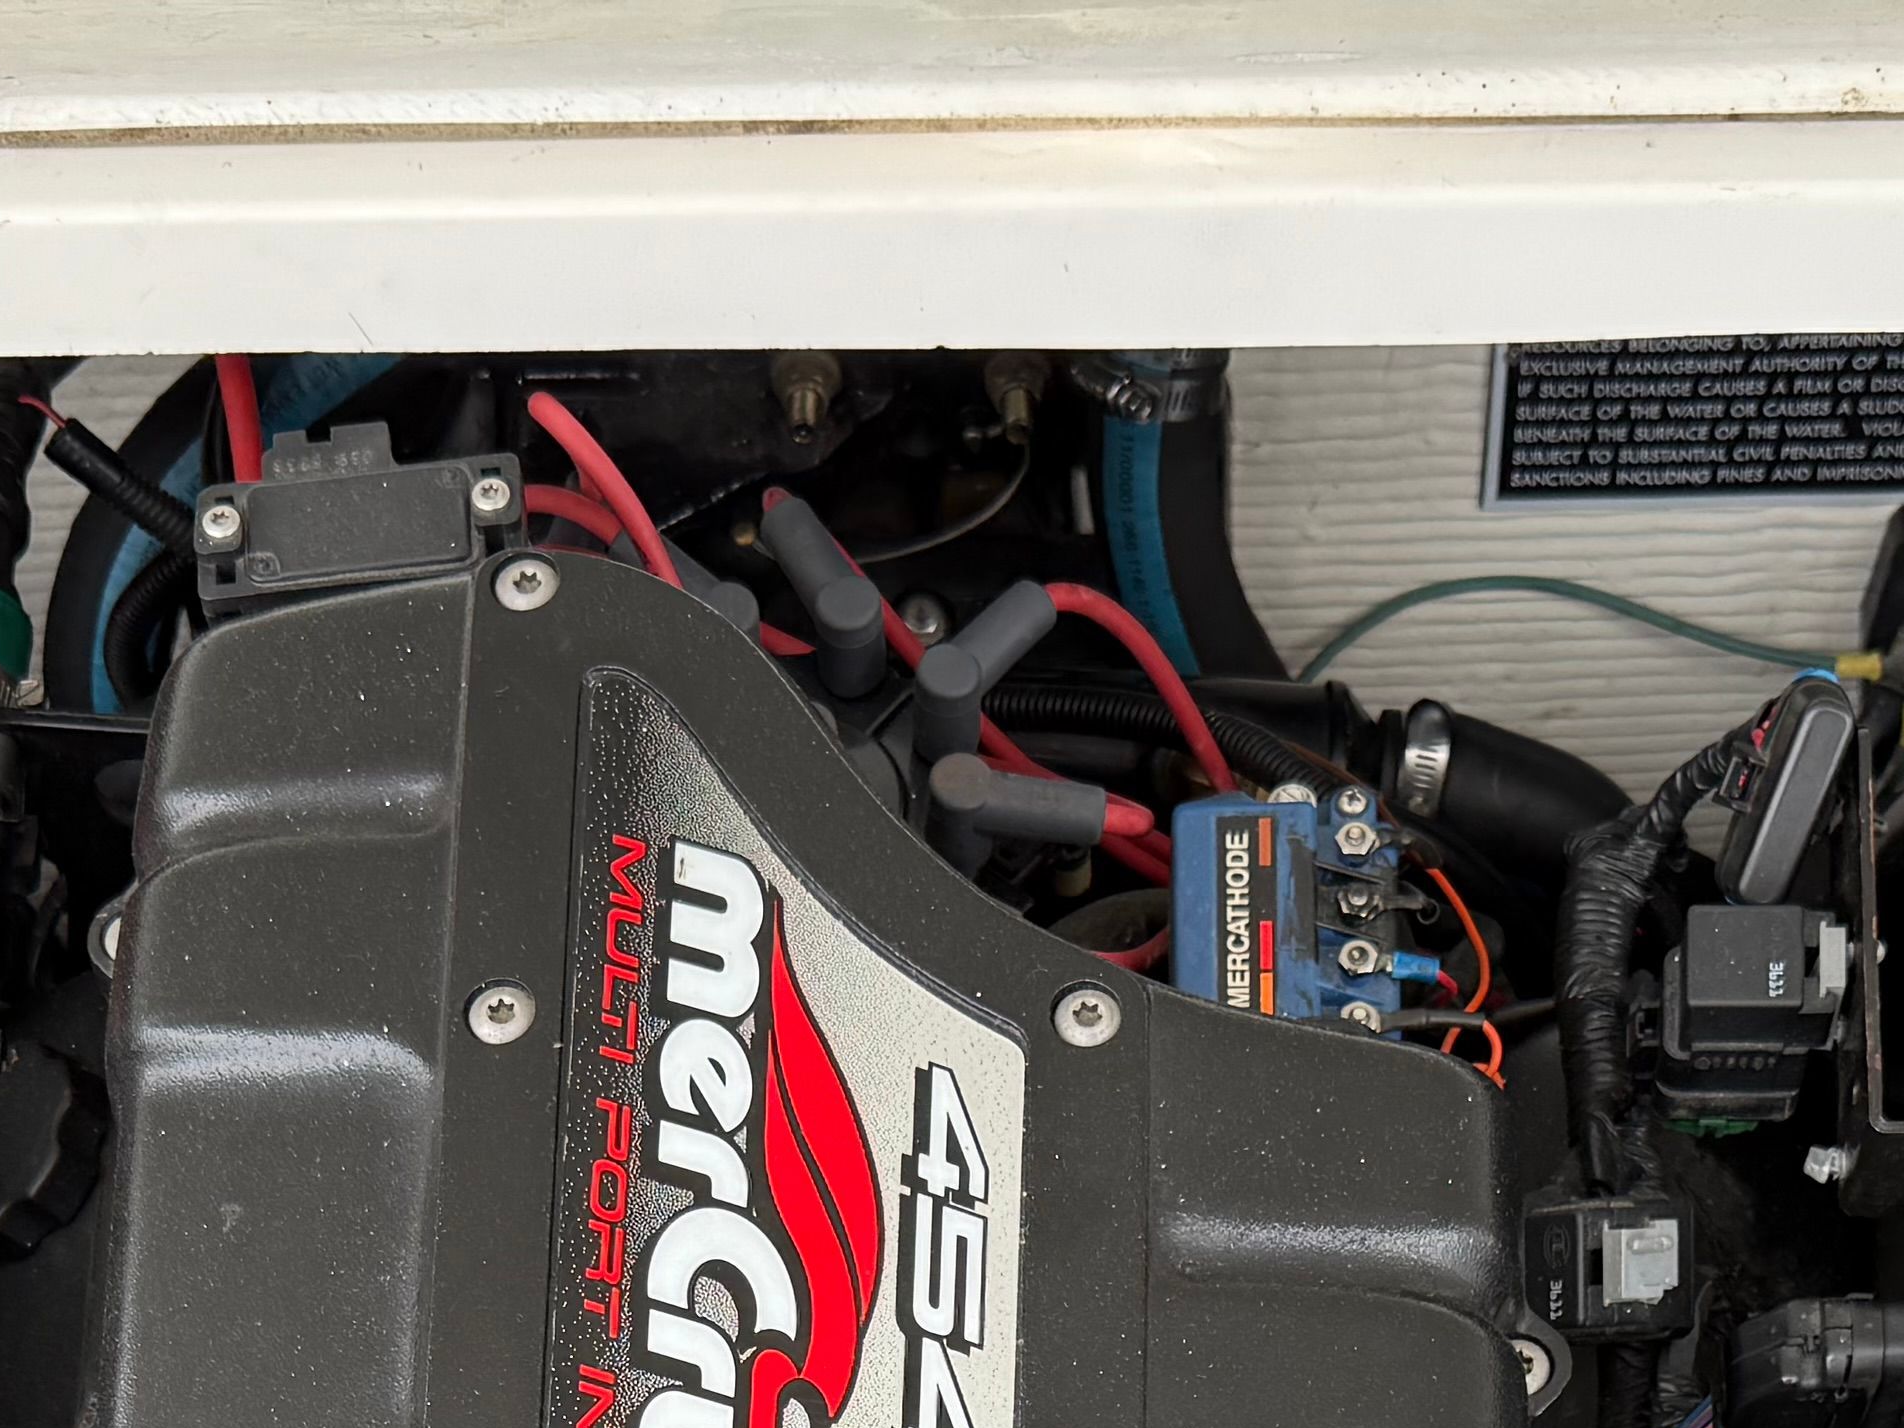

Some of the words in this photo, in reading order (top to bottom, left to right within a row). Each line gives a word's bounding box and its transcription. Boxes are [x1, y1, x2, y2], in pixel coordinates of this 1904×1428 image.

[1667, 400, 1725, 419] WATER
[1763, 399, 1832, 418] CAUSES
[1698, 377, 1768, 396] CAUSES
[1510, 470, 1611, 488] SANCTIONS
[1616, 467, 1712, 486] INCLUDING
[1717, 466, 1766, 484] FINES
[1771, 464, 1812, 482] AND
[598, 832, 648, 1066] MULTI
[1225, 829, 1251, 1009] MERCATHODE
[583, 1097, 636, 1340] PORT
